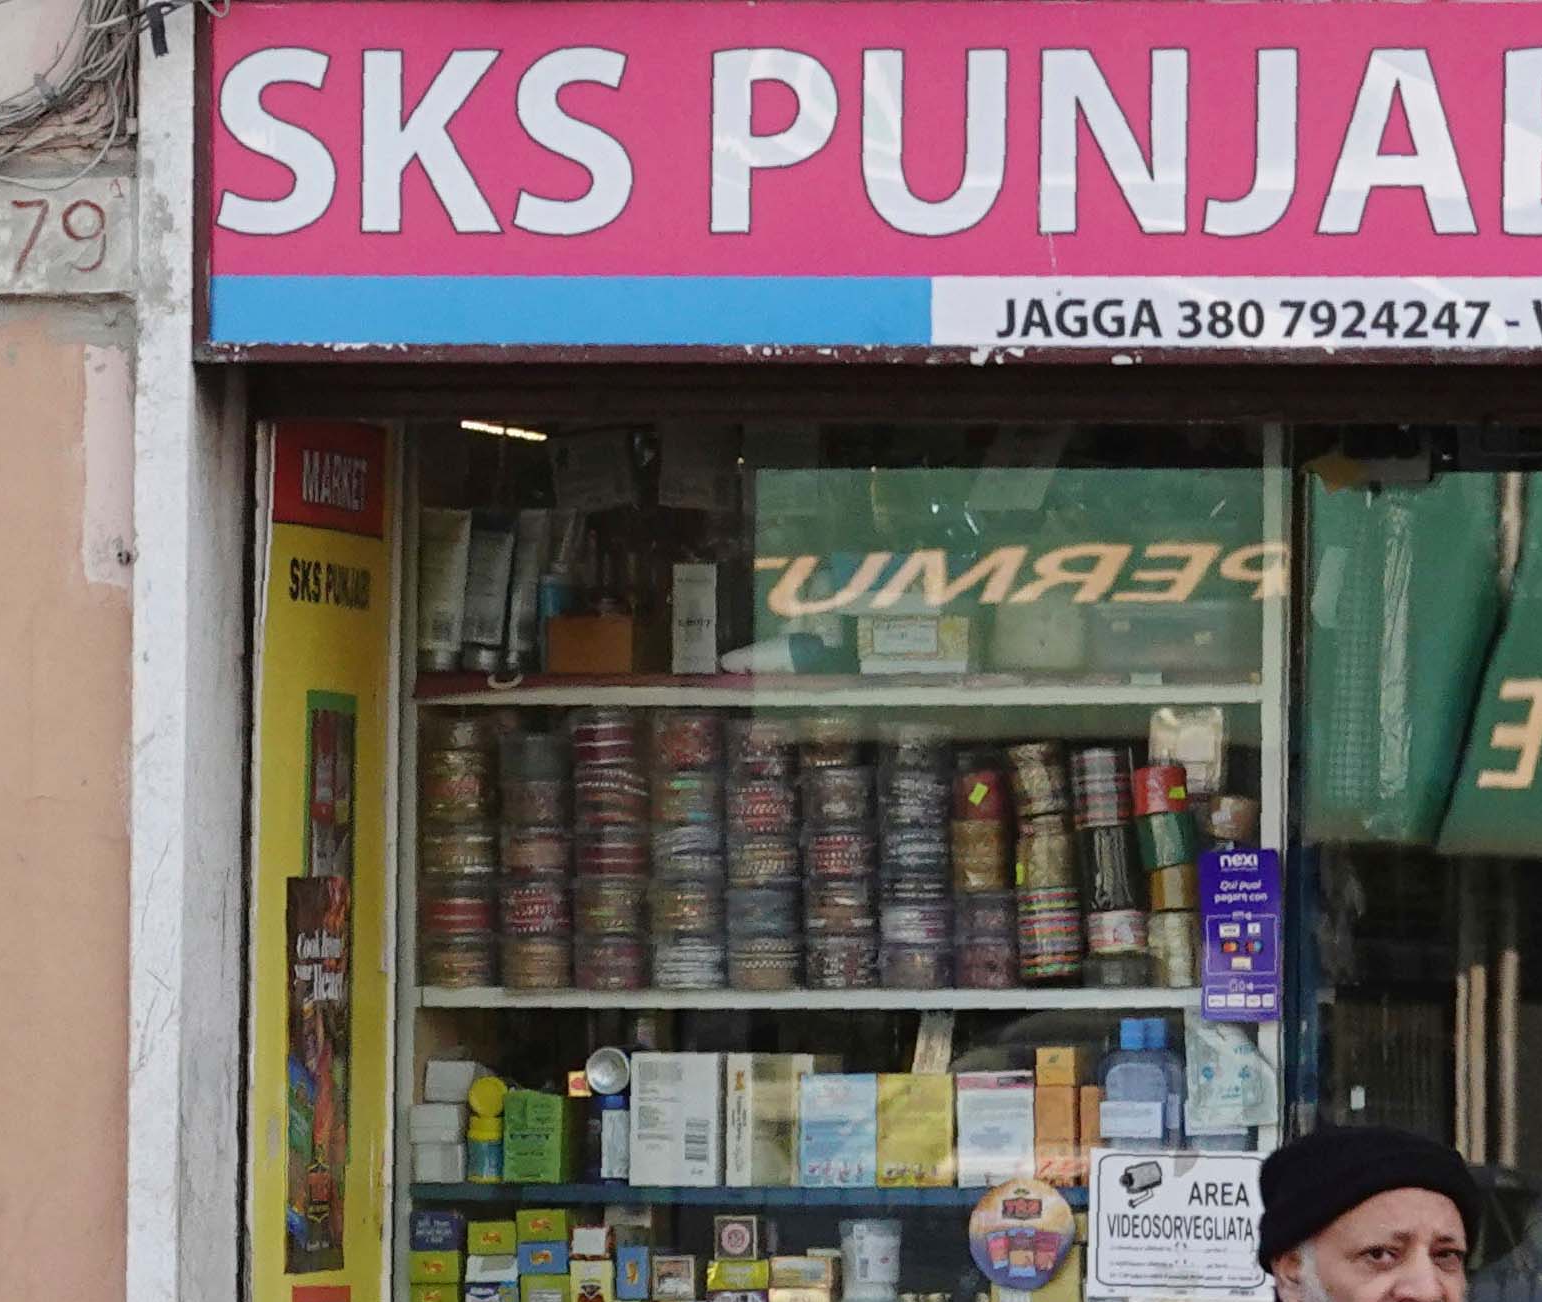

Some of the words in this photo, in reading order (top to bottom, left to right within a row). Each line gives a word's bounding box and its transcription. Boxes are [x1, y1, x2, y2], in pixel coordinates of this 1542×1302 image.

[215, 46, 635, 236] SKS
[11, 199, 108, 273] 79
[996, 298, 1161, 342] JAGGA
[1177, 300, 1265, 341] 380
[1279, 300, 1491, 341] 7924247
[288, 556, 323, 604] SKS
[1219, 853, 1259, 868] nexi
[1188, 1181, 1250, 1207] AREA
[1107, 1213, 1255, 1241] VIDEOSORVEGLIATA
